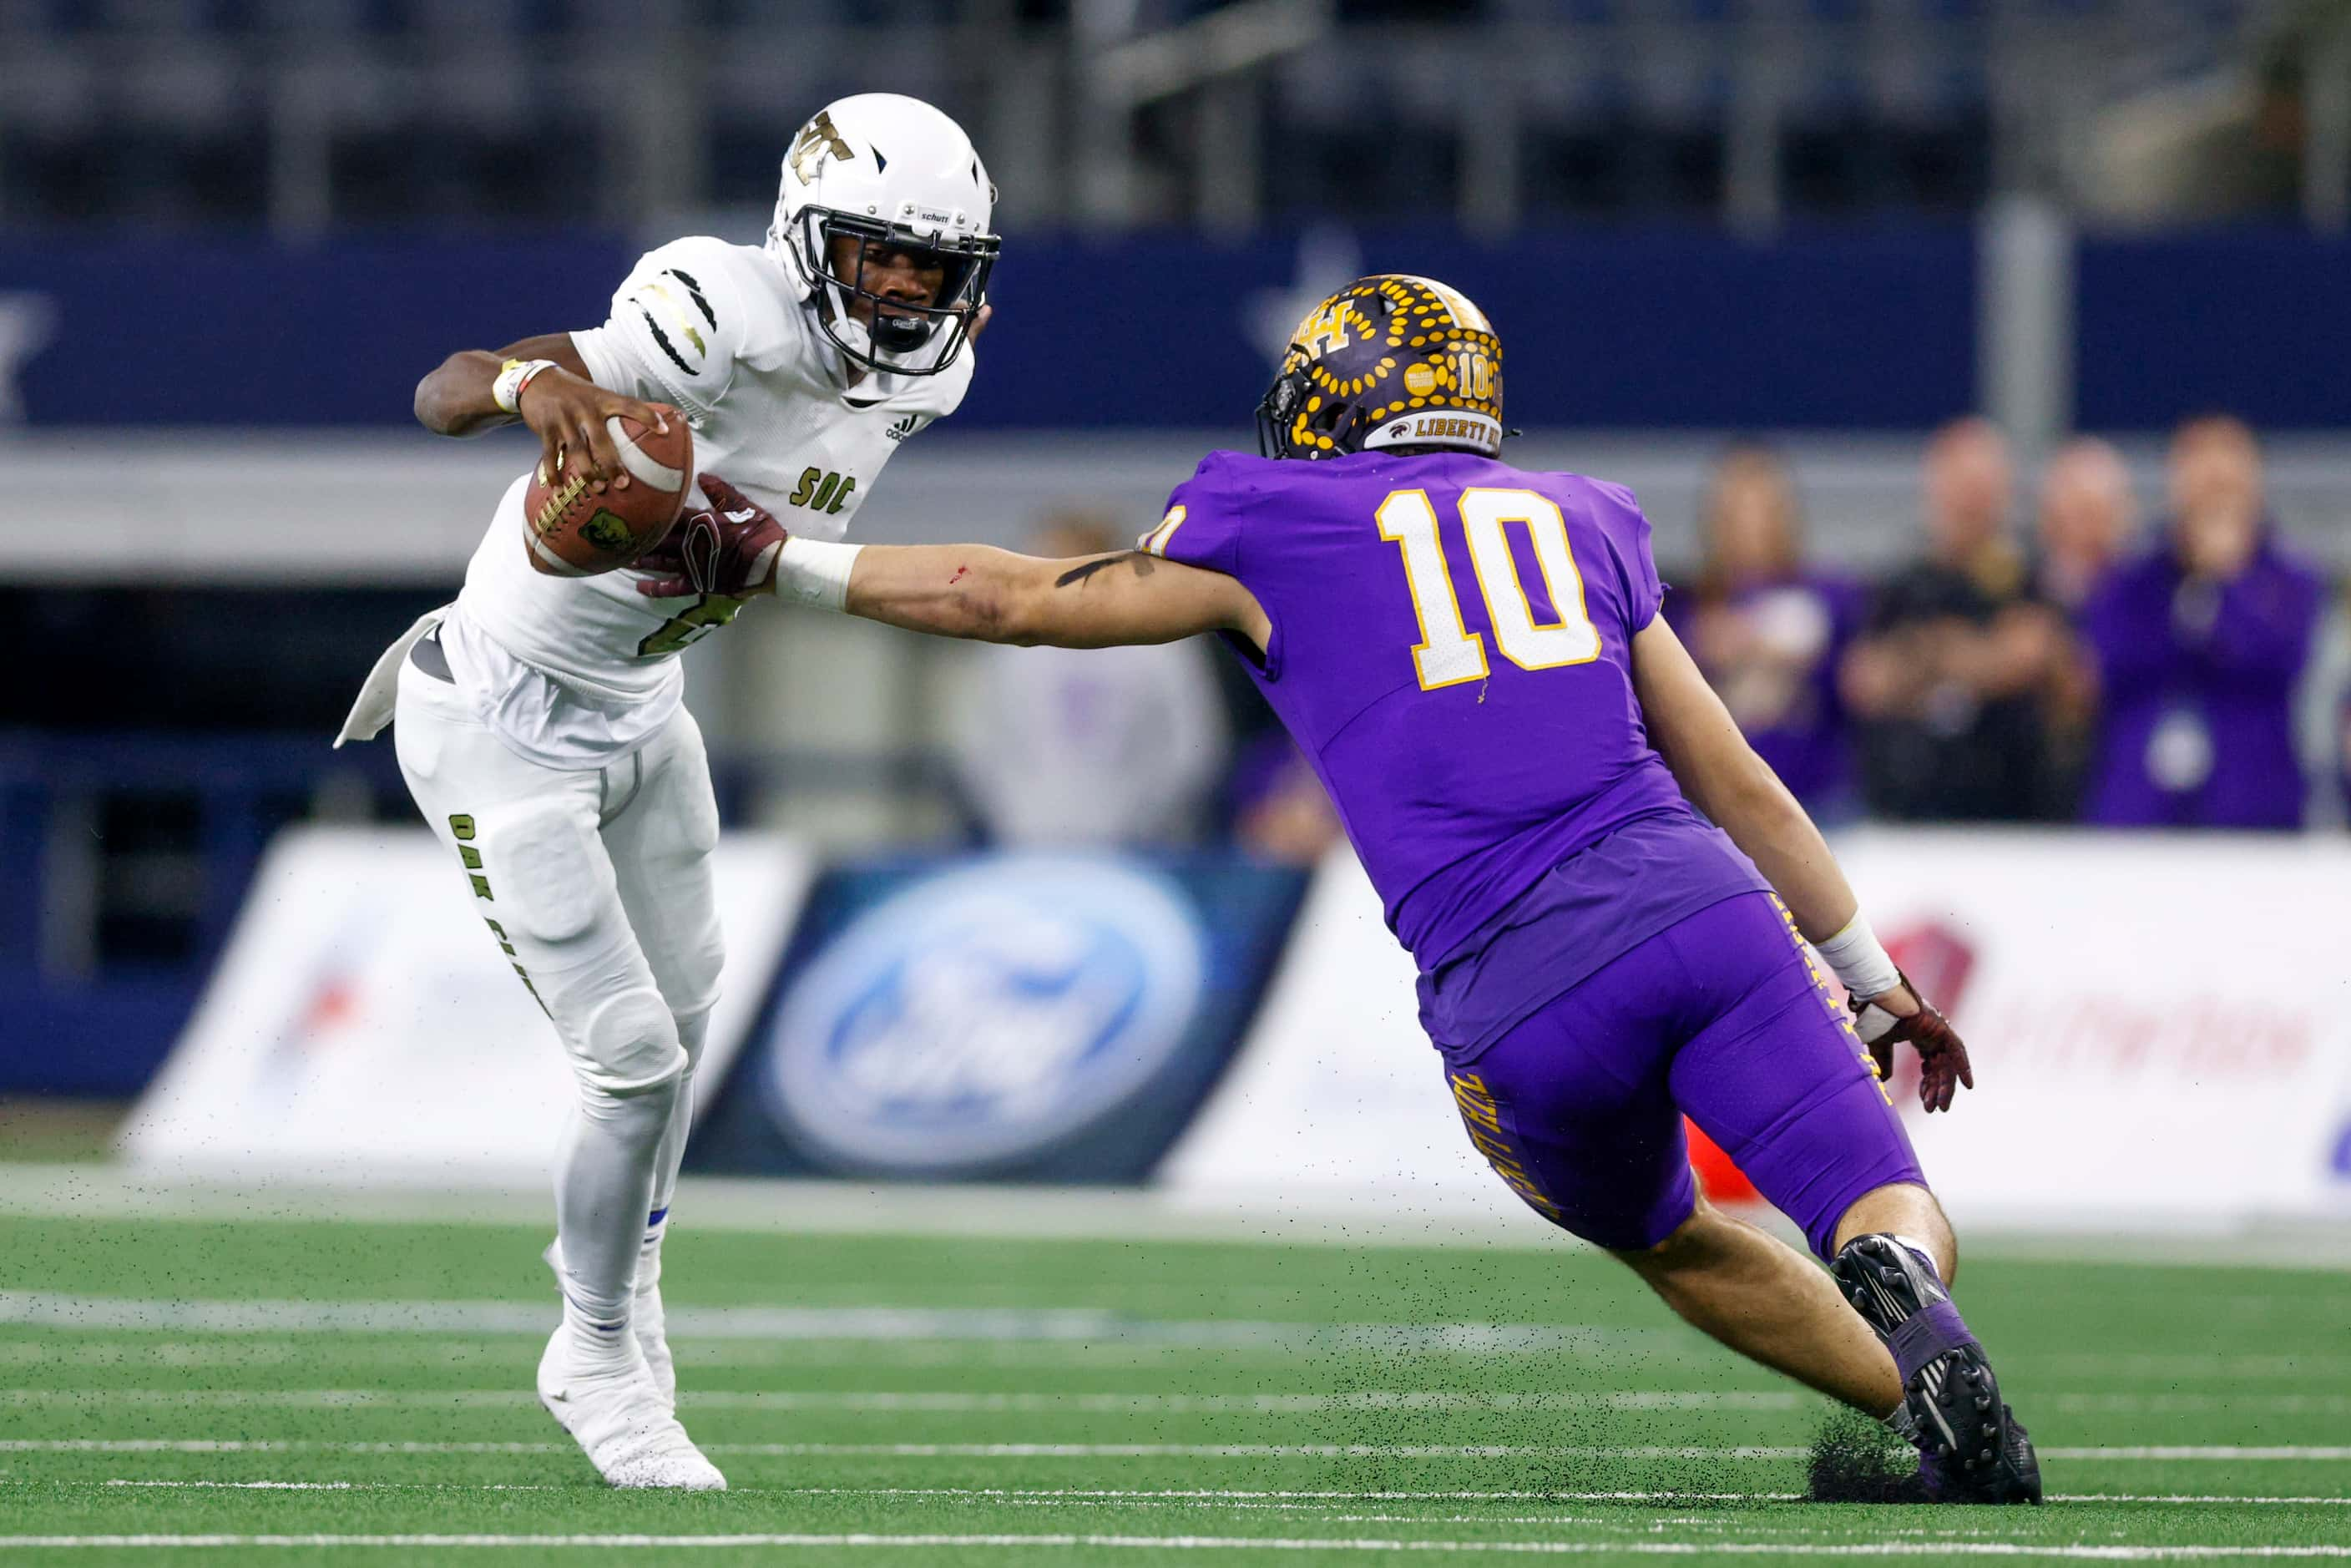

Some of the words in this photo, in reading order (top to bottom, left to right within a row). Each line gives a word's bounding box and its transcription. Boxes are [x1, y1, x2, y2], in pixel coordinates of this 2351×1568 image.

[921, 212, 949, 224] schutt
[1458, 352, 1489, 400] 10
[1414, 418, 1487, 442] LIBERTY
[1374, 486, 1603, 691] 10
